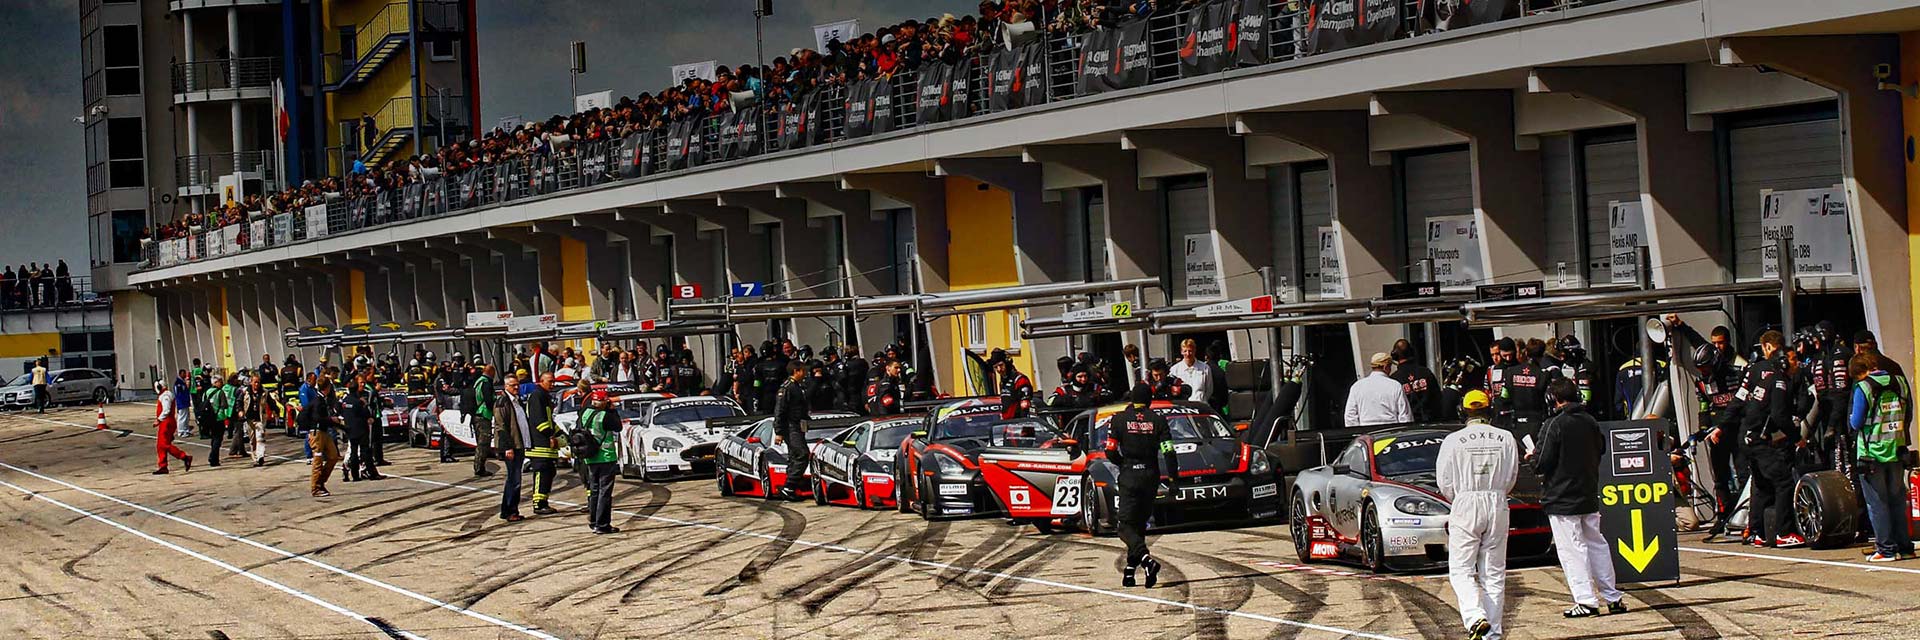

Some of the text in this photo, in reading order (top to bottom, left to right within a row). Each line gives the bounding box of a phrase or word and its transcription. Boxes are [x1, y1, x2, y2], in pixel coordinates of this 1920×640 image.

[1763, 225, 1794, 241] Hexis AMR
[1612, 233, 1638, 249] Hexis AMR
[1765, 246, 1777, 259] Asto
[681, 286, 694, 298] 8
[741, 284, 754, 297] 7
[1114, 304, 1129, 316] 22
[660, 400, 733, 411] BLANCPAIN
[1459, 431, 1505, 444] BOXEN
[1056, 486, 1080, 508] 23
[1175, 486, 1227, 501] JRM
[1602, 482, 1668, 506] STOP
[1390, 536, 1418, 546] HEXIS
